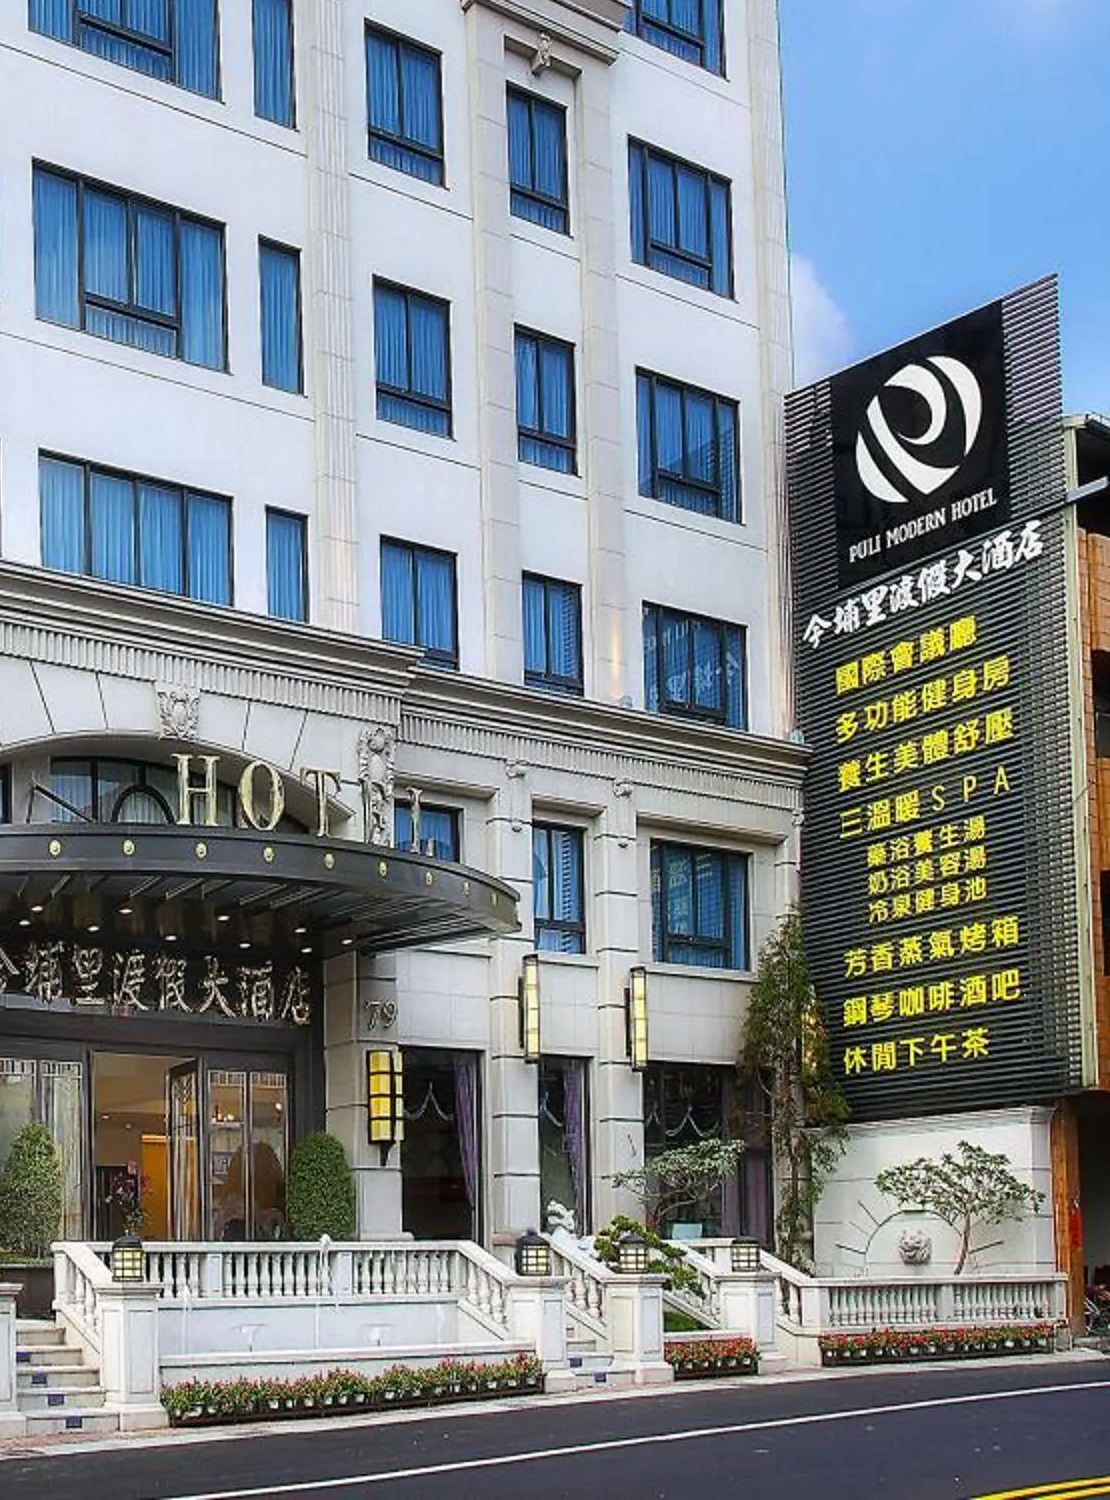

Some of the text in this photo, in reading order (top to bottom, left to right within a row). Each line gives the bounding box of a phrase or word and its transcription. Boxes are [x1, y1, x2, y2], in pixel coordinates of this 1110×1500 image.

[849, 487, 998, 563] PULI MODERN HOTEL
[835, 654, 1011, 743] 多功能健身房
[838, 706, 1014, 792] 養生美體舒壓
[840, 789, 921, 838] 三溫暖
[843, 915, 1020, 979] 芳香蒸氣烤箱
[842, 967, 1022, 1028] 鋼琴咖啡酒吧
[842, 1026, 991, 1076] 休閒下午茶
